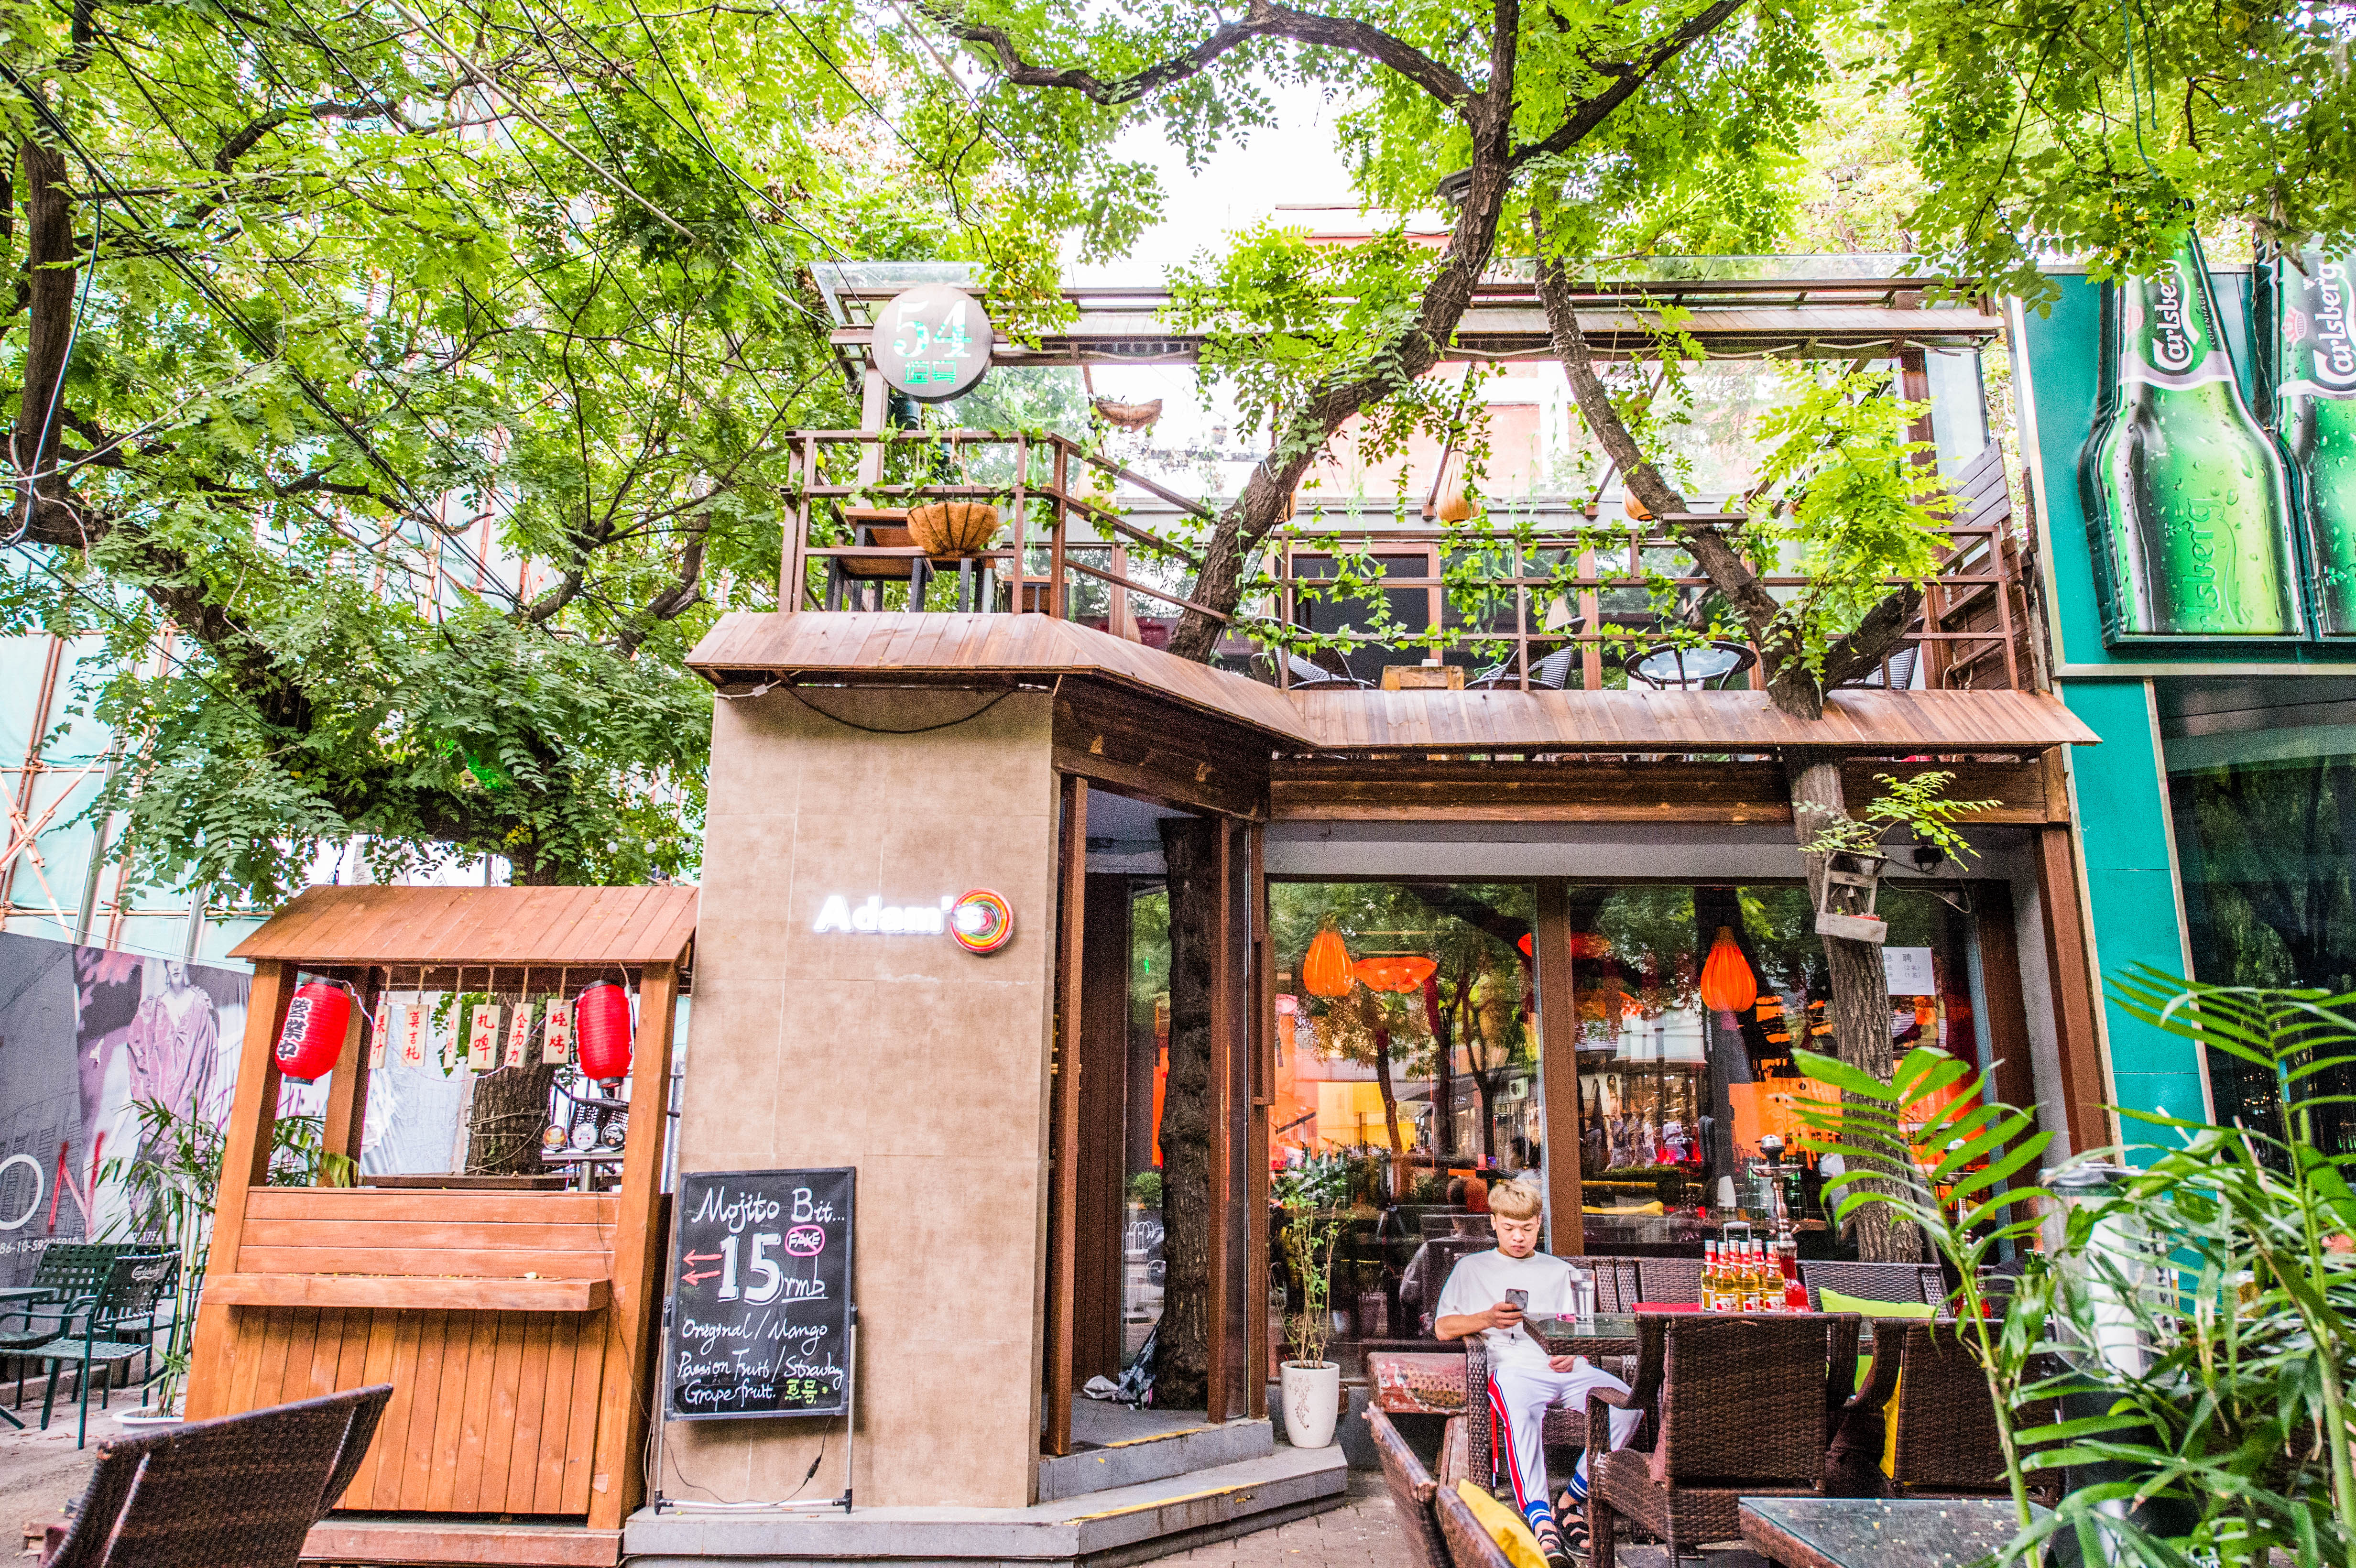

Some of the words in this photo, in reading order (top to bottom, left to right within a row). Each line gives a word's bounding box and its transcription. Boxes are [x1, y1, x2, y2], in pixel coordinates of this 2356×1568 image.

[893, 300, 972, 358] 54
[2196, 287, 2216, 346] COPENHAGEN
[814, 895, 982, 932] Adam's
[373, 1014, 386, 1059] 果汁
[405, 1011, 420, 1060] 莫吉托
[474, 1013, 495, 1061] 扎啤
[549, 1011, 567, 1055] 烧烤
[691, 1186, 780, 1233] Mojito
[788, 1232, 820, 1248] FAKE
[718, 1233, 785, 1306] 15
[767, 1318, 828, 1356] Mango
[677, 1350, 731, 1378] Passion
[732, 1348, 770, 1381] Fruit
